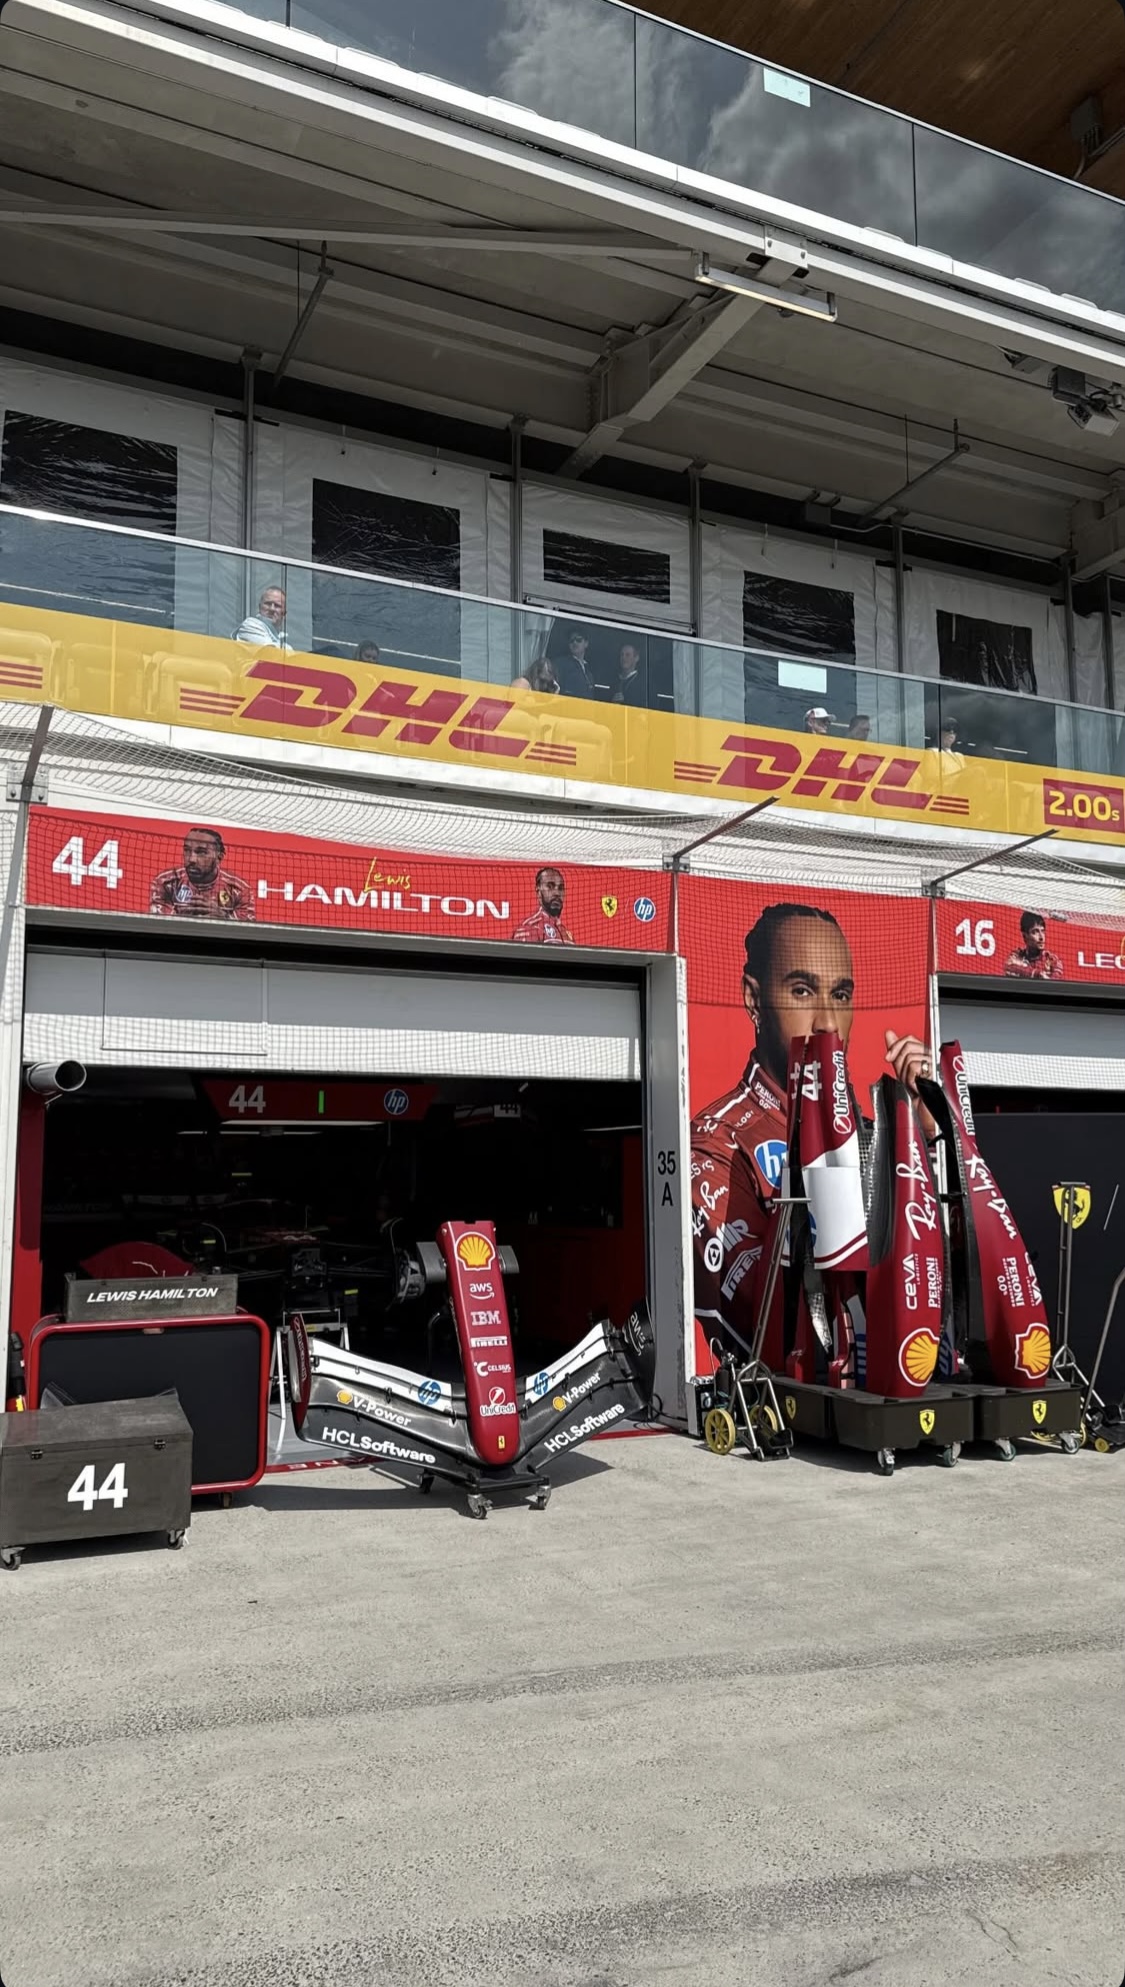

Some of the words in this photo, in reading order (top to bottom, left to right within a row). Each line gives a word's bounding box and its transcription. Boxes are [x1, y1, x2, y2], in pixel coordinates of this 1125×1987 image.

[240, 660, 531, 758] DHL
[717, 735, 933, 811] DHL
[1049, 790, 1120, 822] 2.00s
[51, 836, 123, 889] 44
[363, 856, 411, 892] Lewis
[257, 879, 510, 919] HAMILTON
[636, 897, 654, 922] hp
[955, 918, 996, 957] 16
[228, 1085, 266, 1114] 44
[802, 1060, 822, 1102] 44
[833, 1050, 851, 1117] UniCredit
[387, 1089, 406, 1113] hp
[955, 1071, 976, 1136] UniCredit
[657, 1150, 676, 1175] 35
[661, 1181, 674, 1207] A
[895, 1140, 937, 1241] Ray-Ban
[86, 1290, 137, 1303] LEWIS
[138, 1287, 219, 1301] HAMILTON
[469, 1282, 494, 1294] aws
[925, 1256, 938, 1308] PERONI
[1006, 1256, 1025, 1307] PERONI
[470, 1310, 502, 1326] IBM
[418, 1380, 441, 1406] hp
[562, 1371, 601, 1404] V-Power
[352, 1395, 412, 1427] V-Power
[480, 1402, 517, 1417] UniCredit
[543, 1402, 626, 1453] HCLSoftware
[321, 1426, 437, 1464] HCLSoftware
[67, 1462, 129, 1511] 44
